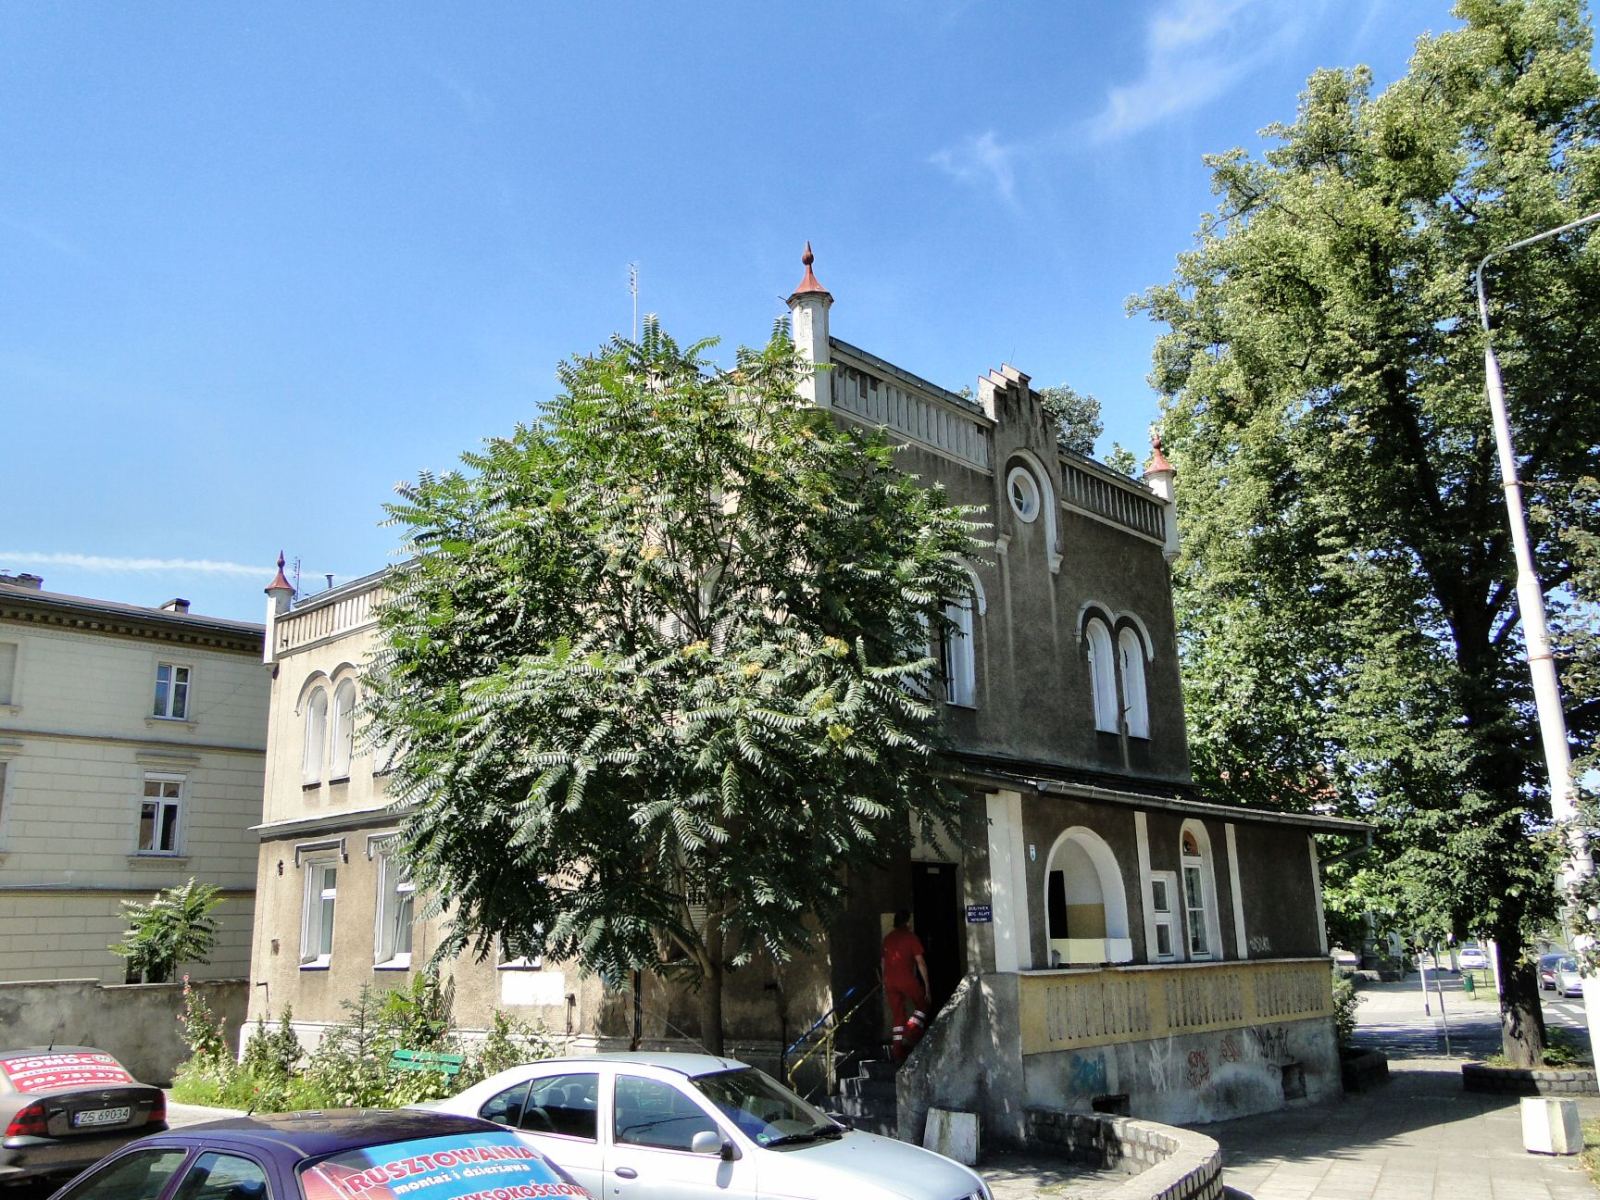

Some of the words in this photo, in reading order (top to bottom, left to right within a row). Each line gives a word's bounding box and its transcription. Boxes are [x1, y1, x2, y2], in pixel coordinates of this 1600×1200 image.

[11, 1057, 95, 1071] POMOC
[80, 1112, 95, 1123] ZS
[343, 1145, 544, 1194] RUSZTOWANIA
[392, 1171, 452, 1194] montaż
[451, 1169, 461, 1180] i
